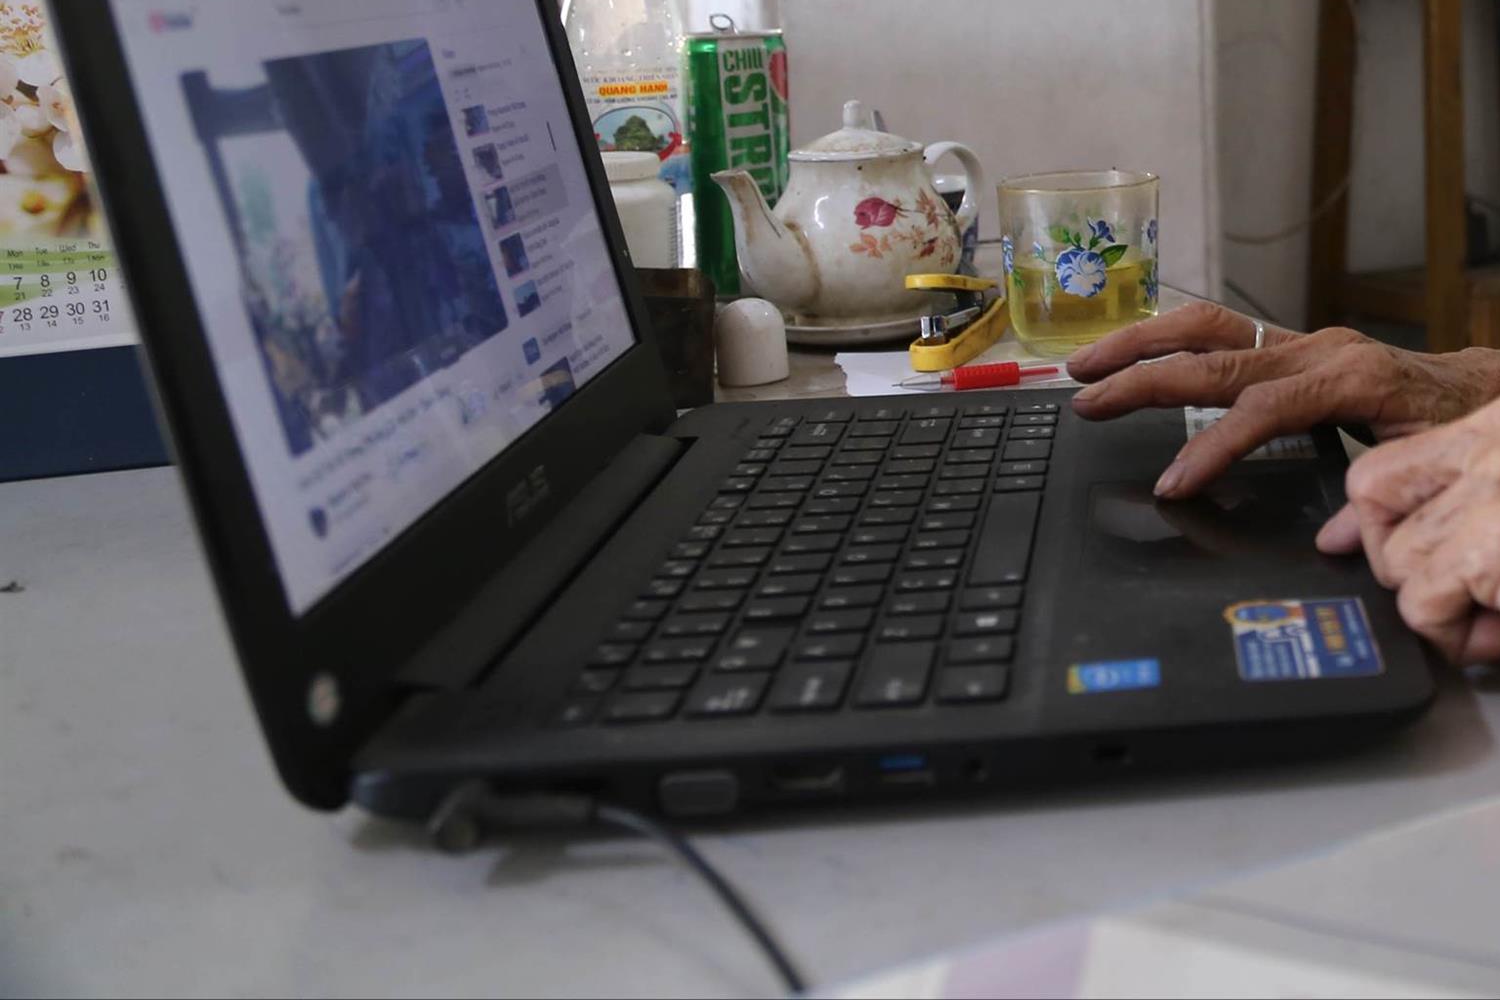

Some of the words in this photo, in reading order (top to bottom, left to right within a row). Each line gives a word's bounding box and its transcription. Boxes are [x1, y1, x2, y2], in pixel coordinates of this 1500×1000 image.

[598, 85, 636, 96] QUANG
[13, 277, 22, 290] 7
[40, 274, 50, 288] 8
[66, 271, 76, 285] 9
[89, 268, 107, 282] 10
[14, 291, 26, 301] 21
[41, 289, 53, 297] 22
[67, 286, 79, 295] 23
[94, 283, 105, 292] 24
[12, 307, 33, 322] 28
[40, 305, 59, 319] 29
[66, 302, 85, 316] 30
[92, 299, 110, 313] 31
